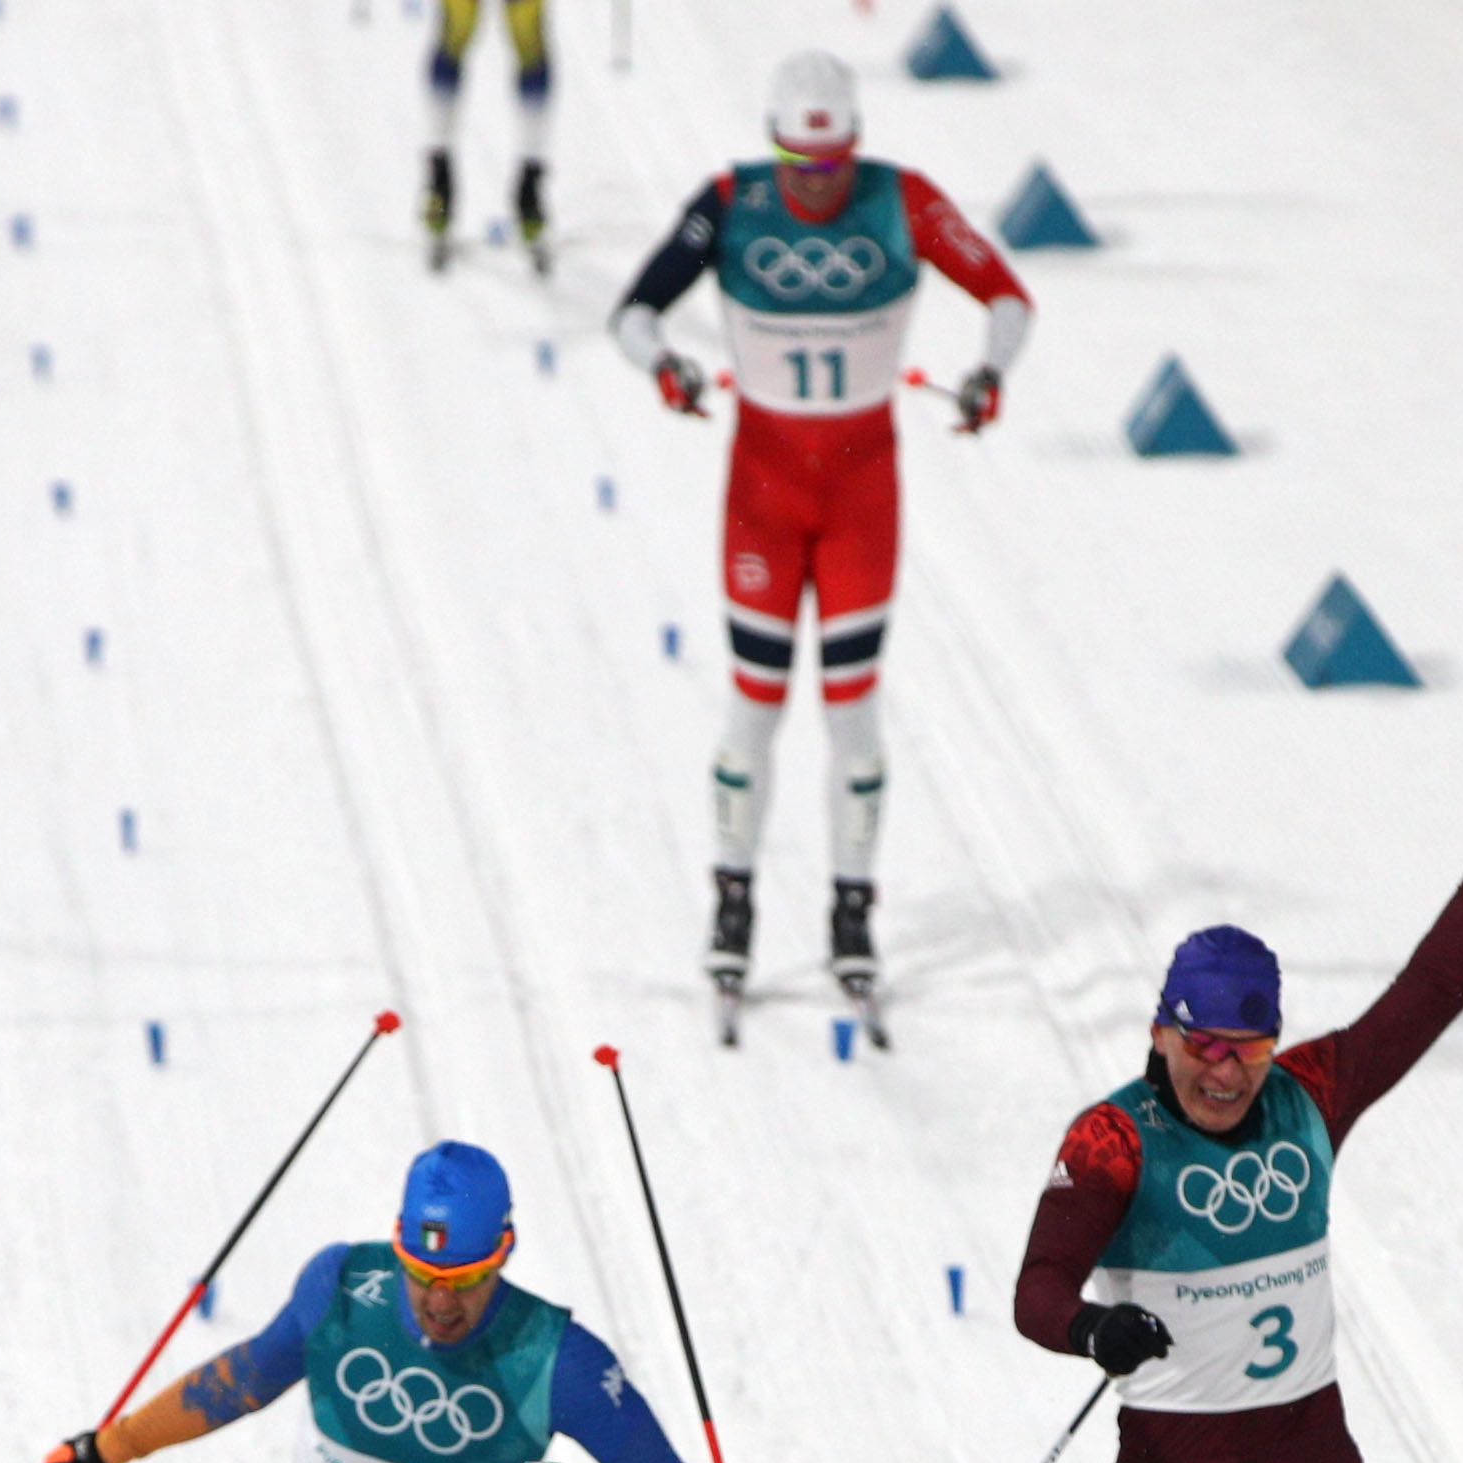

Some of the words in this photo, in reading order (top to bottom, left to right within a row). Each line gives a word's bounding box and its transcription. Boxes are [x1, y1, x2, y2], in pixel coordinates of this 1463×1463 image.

[783, 346, 846, 400] 11
[1176, 1267, 1305, 1304] PyeongChang
[1244, 1304, 1299, 1380] 3
